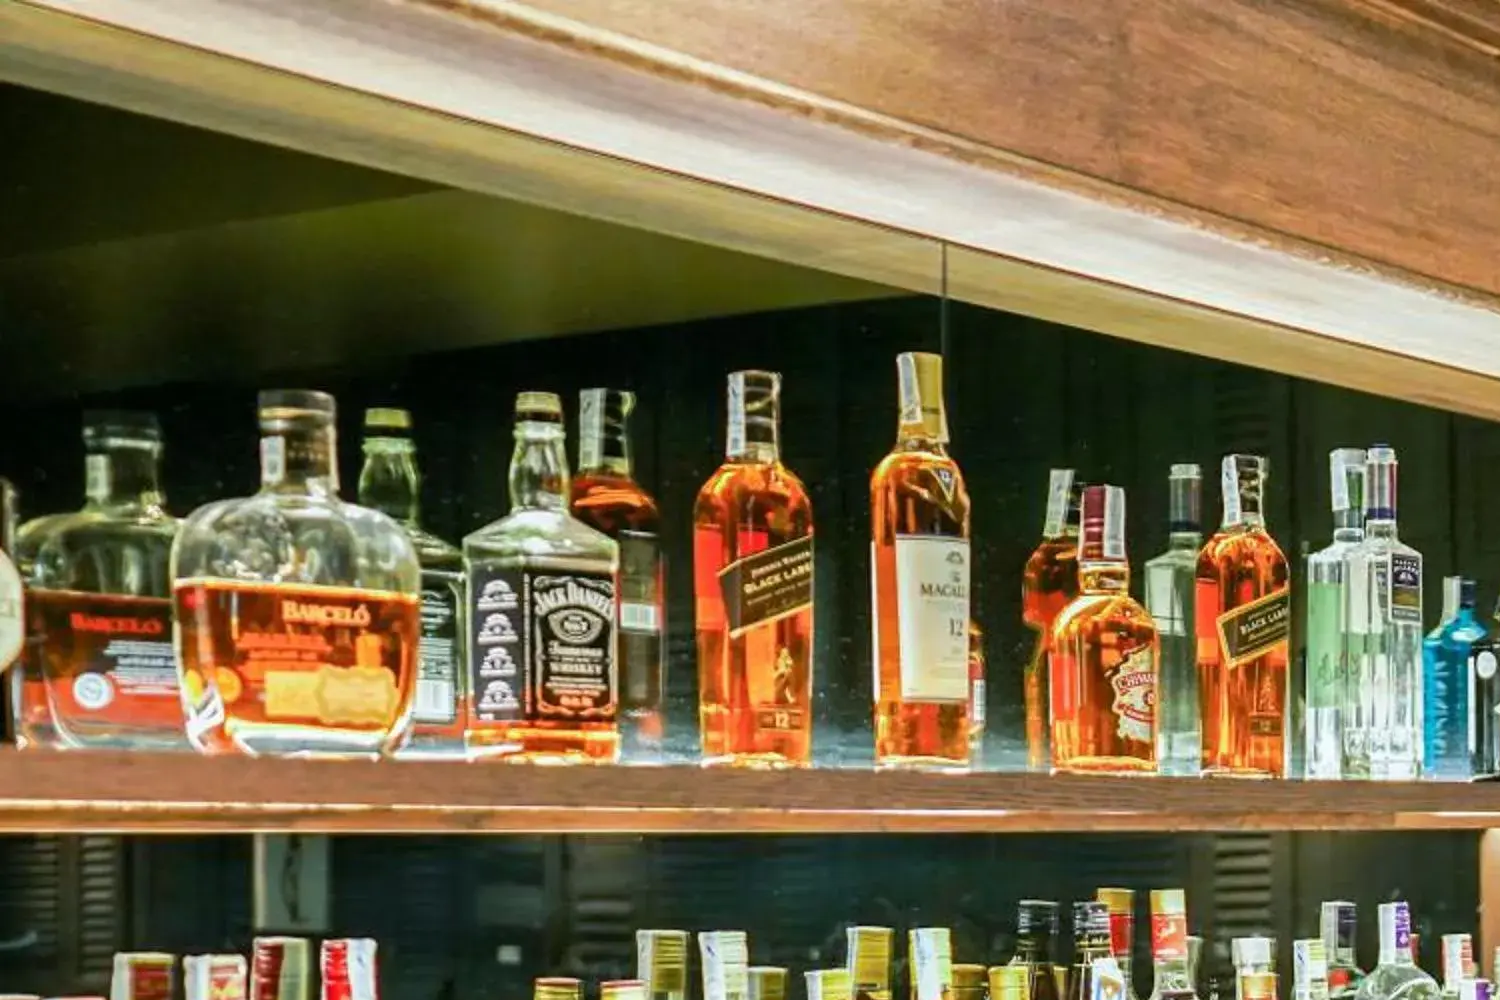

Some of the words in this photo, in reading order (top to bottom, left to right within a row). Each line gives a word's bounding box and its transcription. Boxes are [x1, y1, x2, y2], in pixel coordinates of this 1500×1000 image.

[744, 573, 782, 595] BLACK
[281, 600, 371, 627] BARCELÓ
[949, 617, 963, 637] 12
